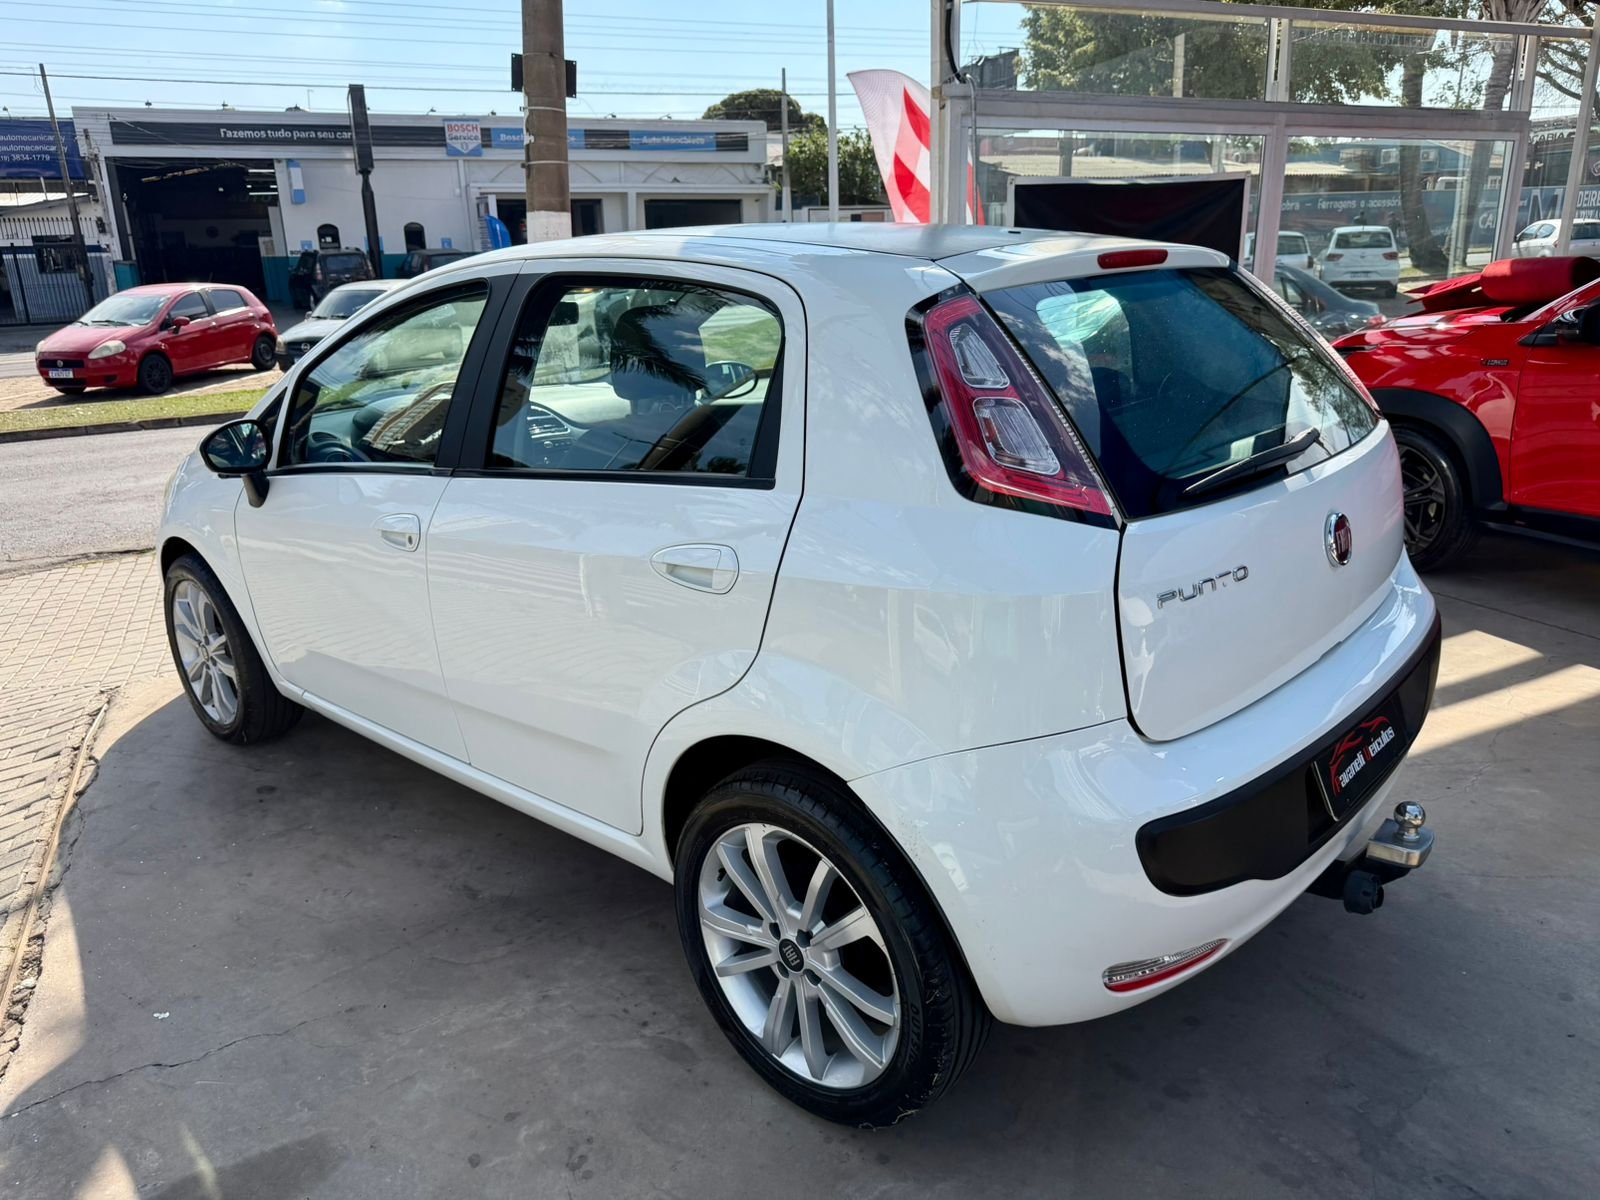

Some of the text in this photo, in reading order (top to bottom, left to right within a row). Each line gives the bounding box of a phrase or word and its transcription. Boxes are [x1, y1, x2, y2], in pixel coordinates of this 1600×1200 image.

[220, 128, 352, 140] Fazemos tudo para seu car
[446, 123, 479, 134] BOSCH
[447, 132, 480, 142] Service
[1317, 198, 1356, 212] Ferragens
[1368, 195, 1401, 209] acessóri
[1157, 565, 1249, 610] PUNTO
[782, 944, 801, 967] FIAT
